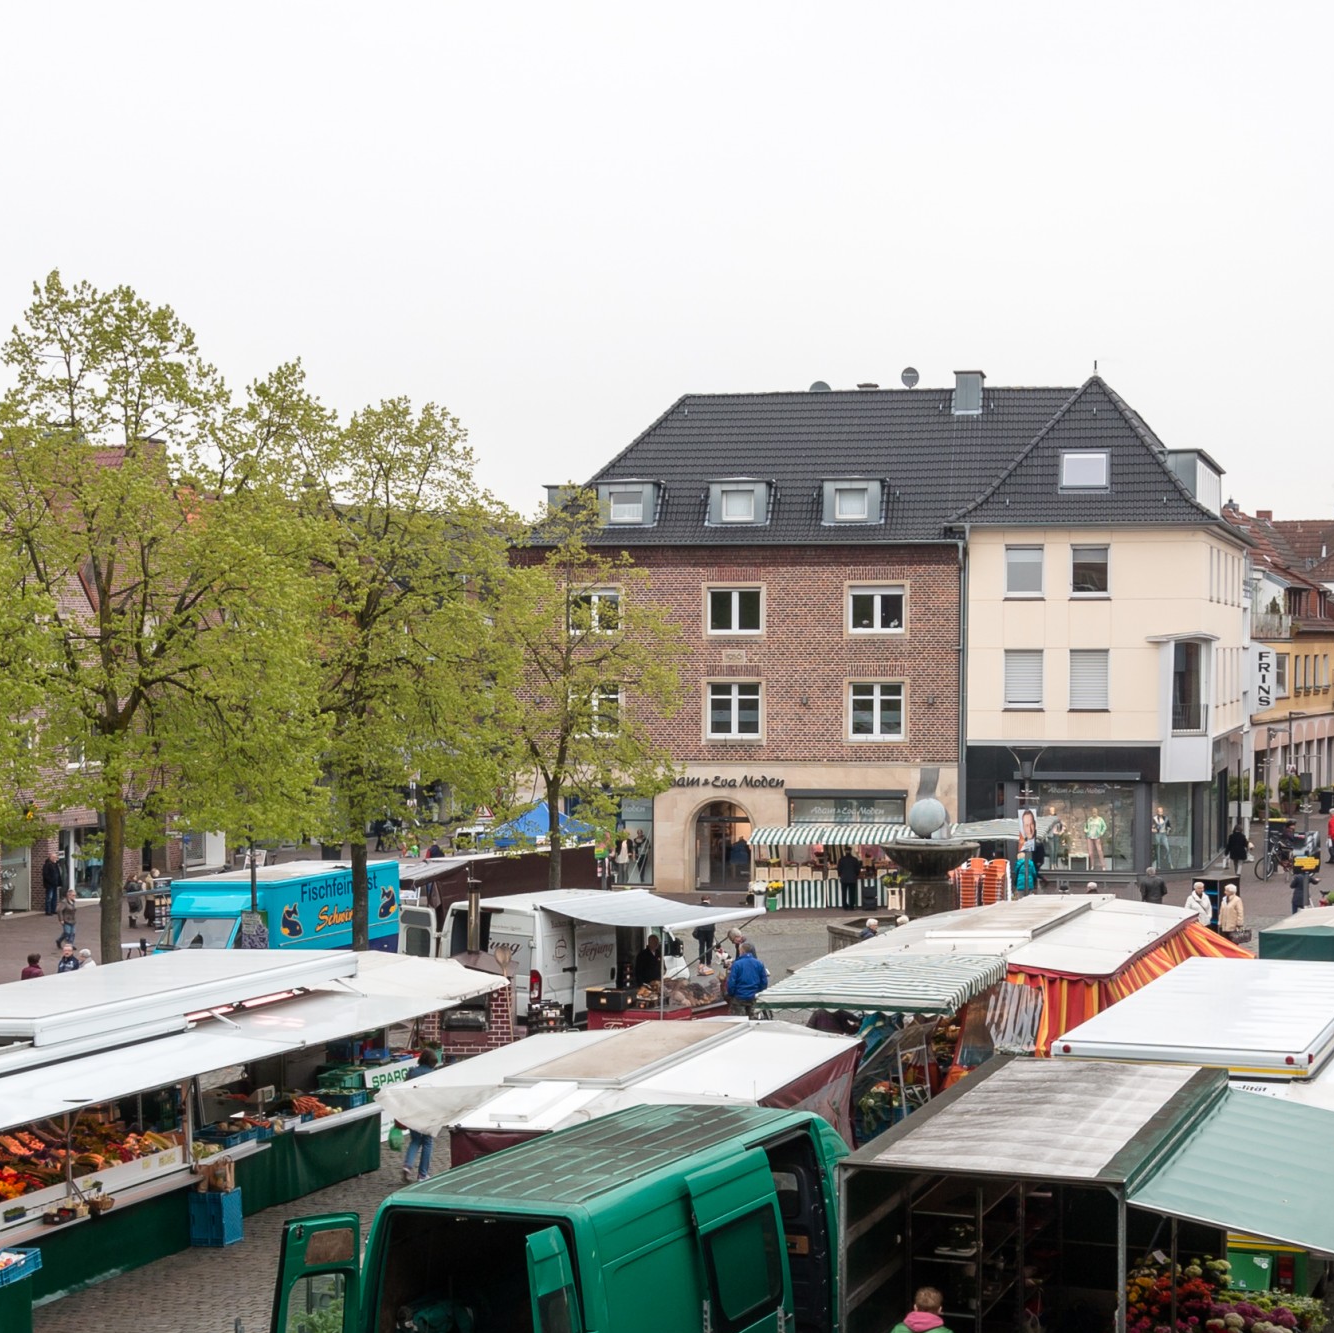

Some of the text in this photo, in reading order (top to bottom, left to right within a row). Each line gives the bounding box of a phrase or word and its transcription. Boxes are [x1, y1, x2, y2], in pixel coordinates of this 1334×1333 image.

[1258, 652, 1270, 706] FRINS
[711, 775, 738, 788] Eva
[739, 774, 785, 789] Moden
[810, 806, 835, 815] Adam
[858, 806, 885, 816] Moden
[300, 872, 378, 903] Fischfeinst
[578, 940, 614, 961] Terjung
